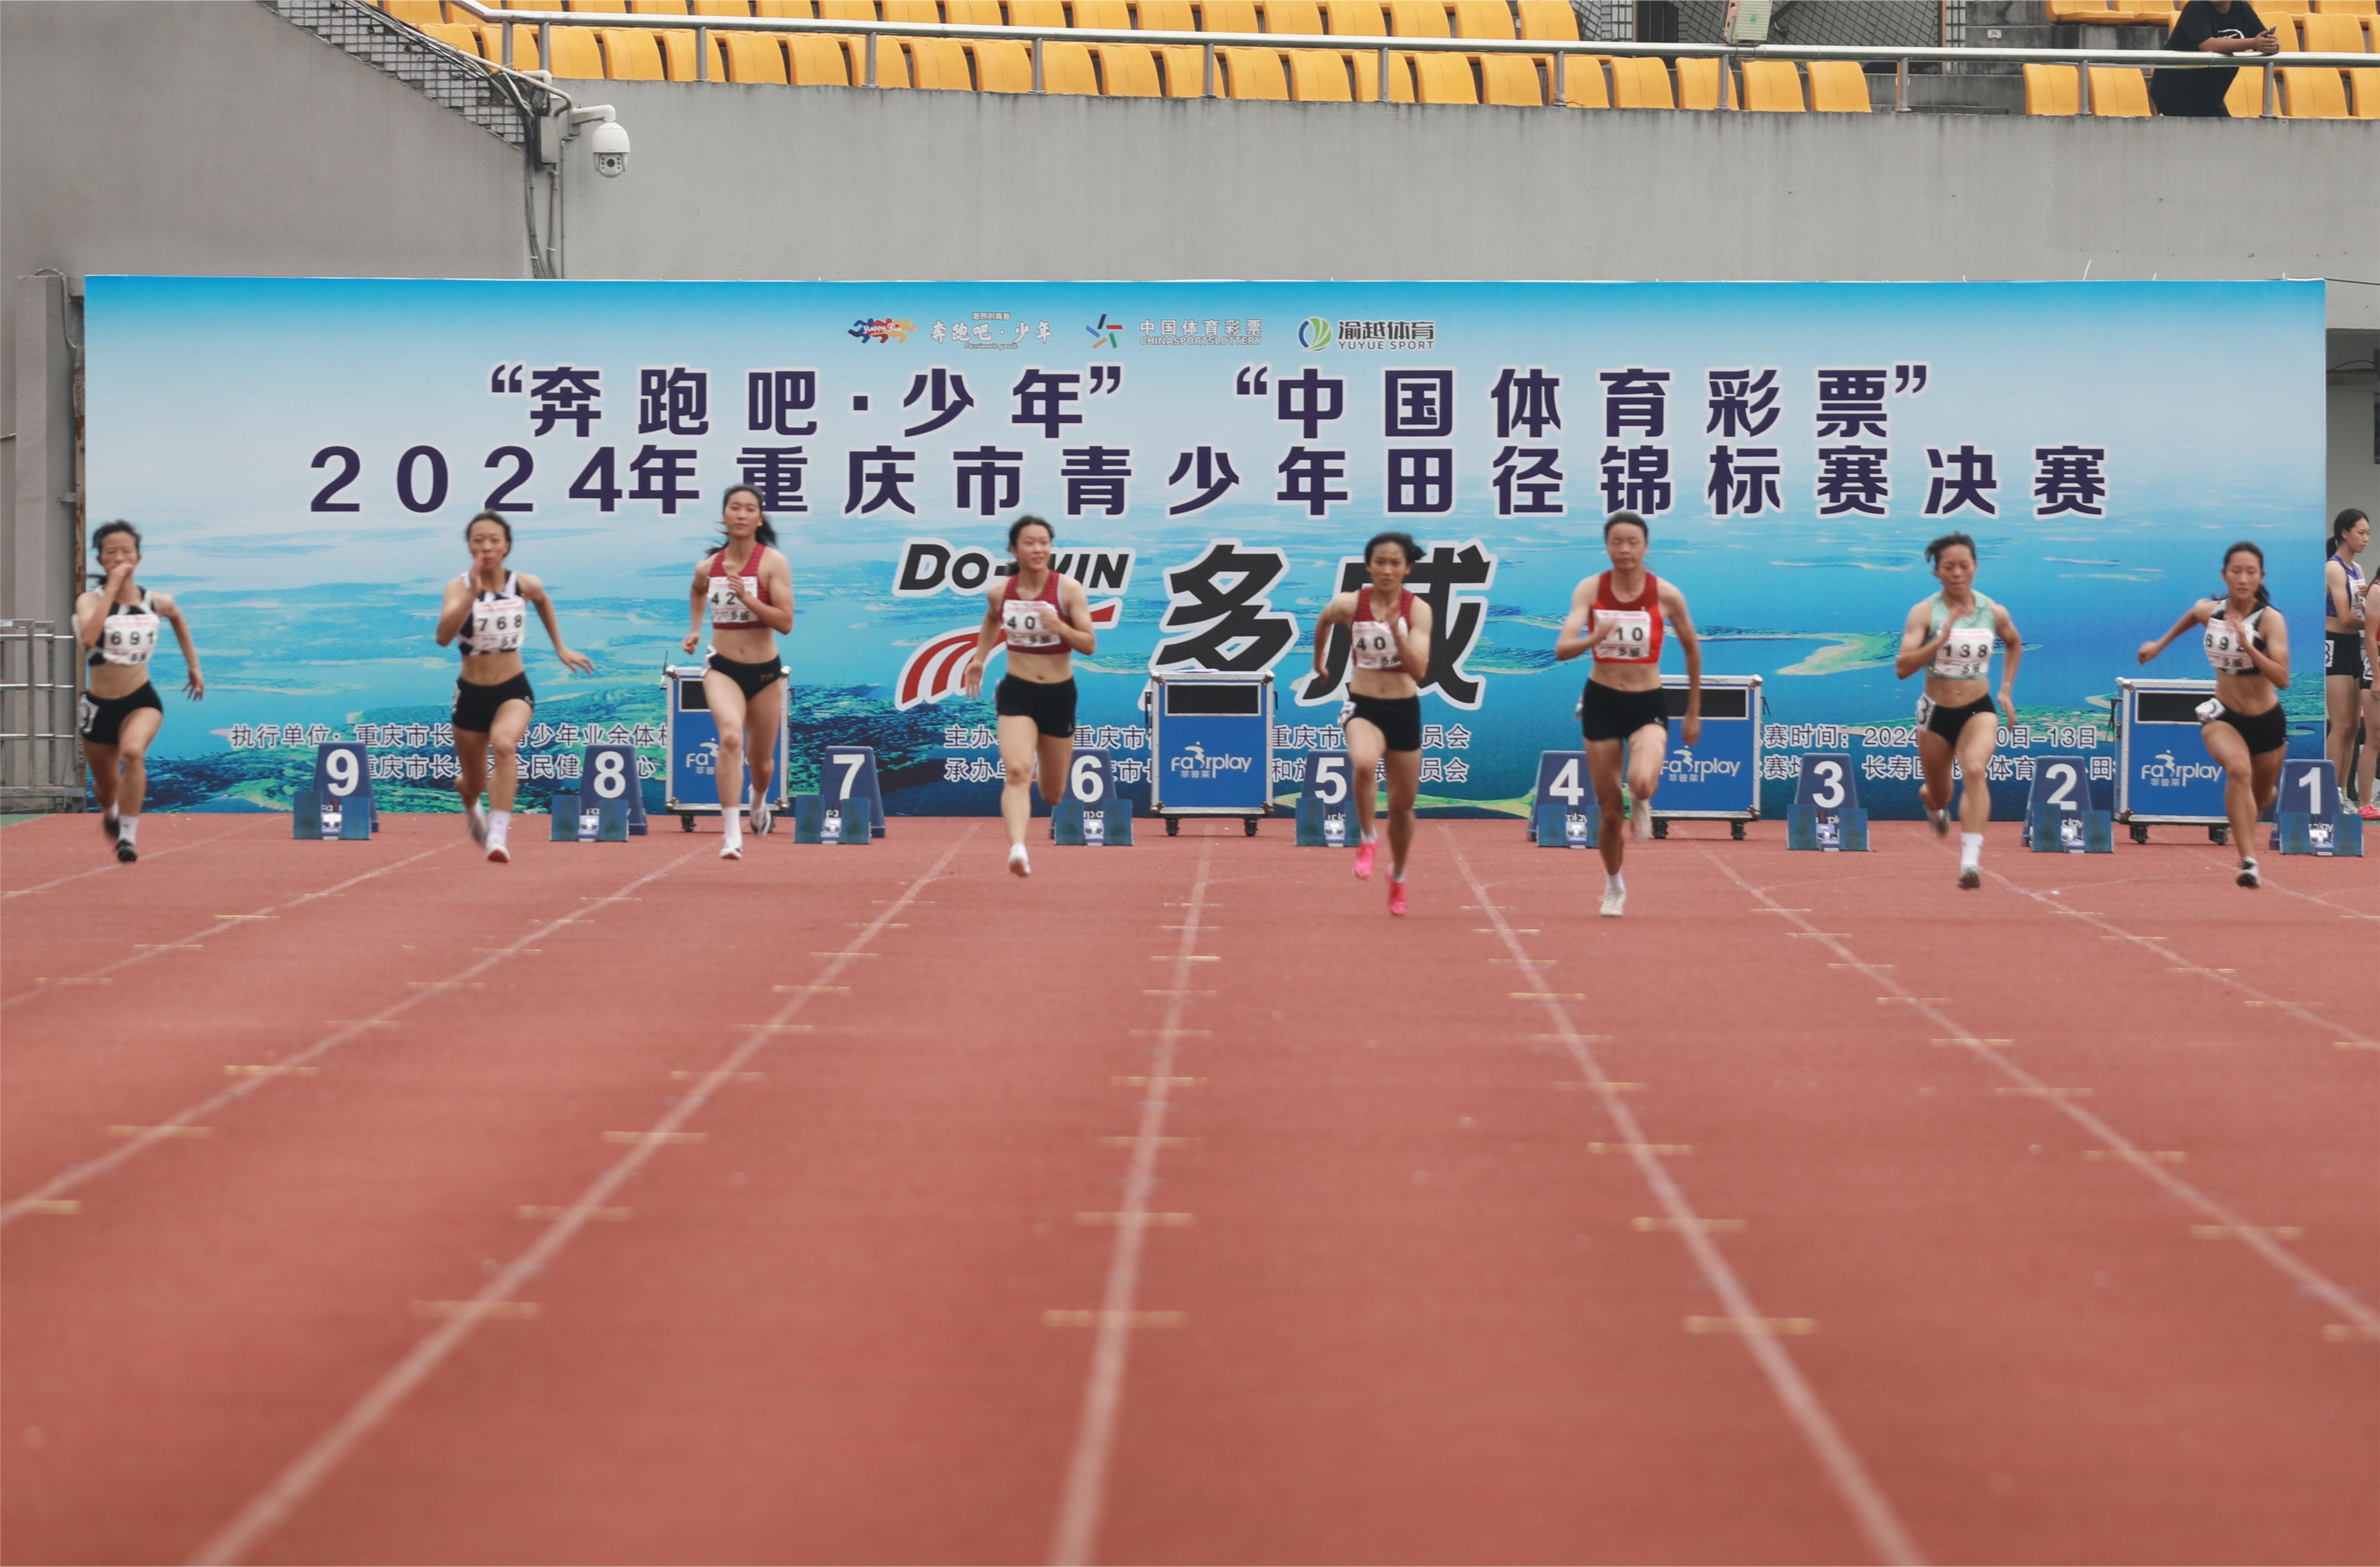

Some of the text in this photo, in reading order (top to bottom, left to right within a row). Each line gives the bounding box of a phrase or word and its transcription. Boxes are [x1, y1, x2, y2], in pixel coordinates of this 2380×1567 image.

[1140, 319, 1262, 336] 中国体育彩票
[1338, 321, 1434, 339] 渝越体育
[1339, 341, 1433, 349] YUYUE SPORT
[711, 592, 753, 605] 42
[478, 615, 522, 632] 768
[1007, 615, 1035, 630] 40
[110, 631, 154, 645] 691
[1604, 627, 1643, 641] 10
[1357, 637, 1386, 651] 40
[1943, 643, 1988, 658] 138
[326, 749, 359, 796] 9
[594, 751, 626, 798] 8
[833, 754, 865, 800] 7
[1071, 755, 1104, 802] 6
[1315, 757, 1347, 804] 5
[1549, 758, 1584, 806] 4
[1812, 760, 1845, 808] 3
[2045, 763, 2077, 810] 2
[2298, 767, 2321, 814] 1
